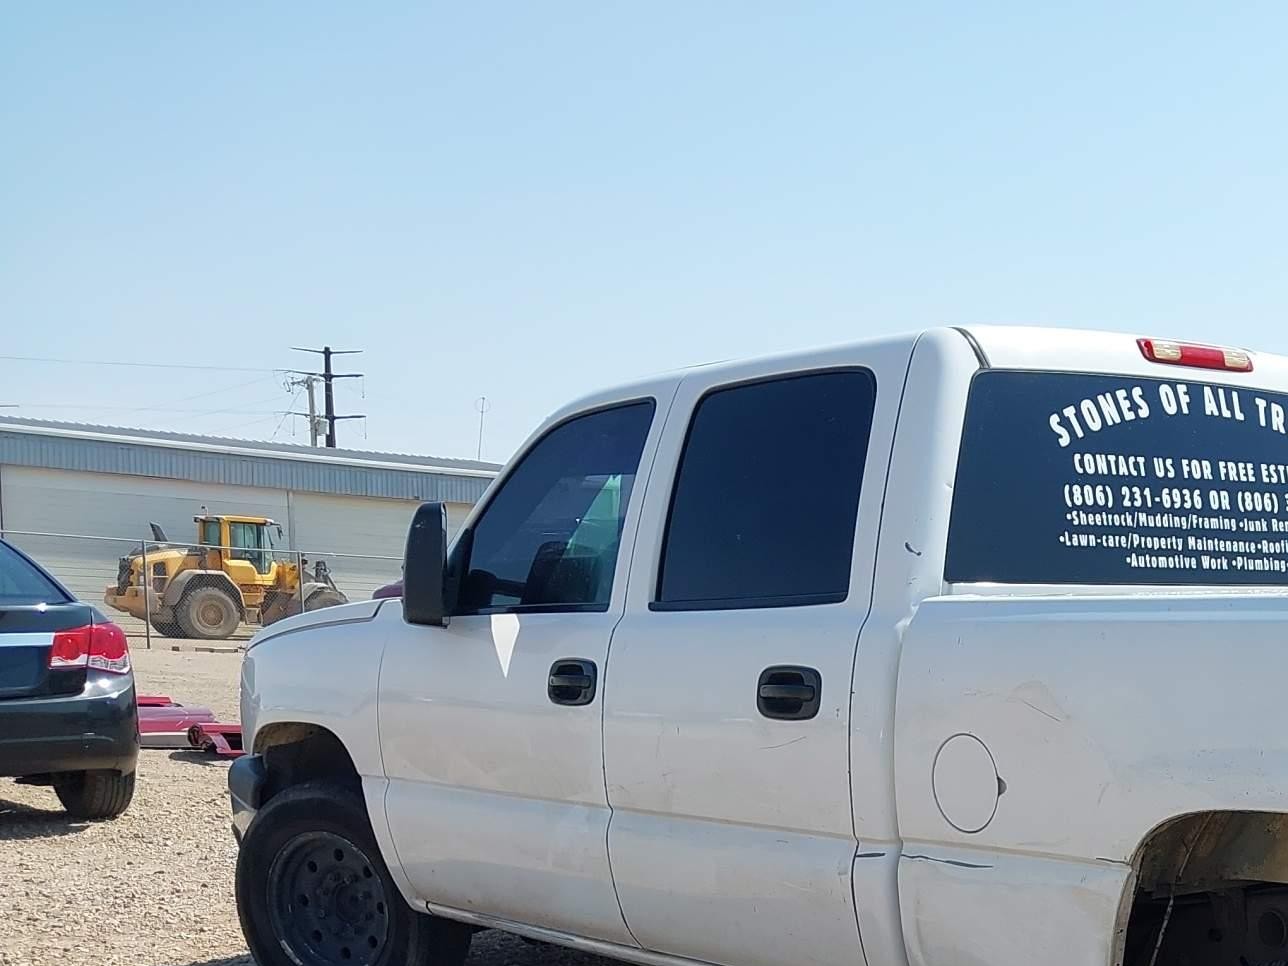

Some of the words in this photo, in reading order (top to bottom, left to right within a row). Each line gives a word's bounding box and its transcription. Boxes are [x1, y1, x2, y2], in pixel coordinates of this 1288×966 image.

[1049, 385, 1150, 447] STONES
[1158, 383, 1190, 415] OF
[1203, 385, 1245, 421] ALL
[1073, 453, 1146, 477] CONTACT
[1153, 457, 1175, 478] US
[1181, 458, 1213, 480] FOR
[1218, 460, 1256, 482] FREE
[1064, 484, 1113, 509] (806)
[1121, 486, 1202, 510] 231-6936
[1209, 490, 1231, 511] OR
[1237, 491, 1279, 514] (806)
[1200, 555, 1229, 570] Work
